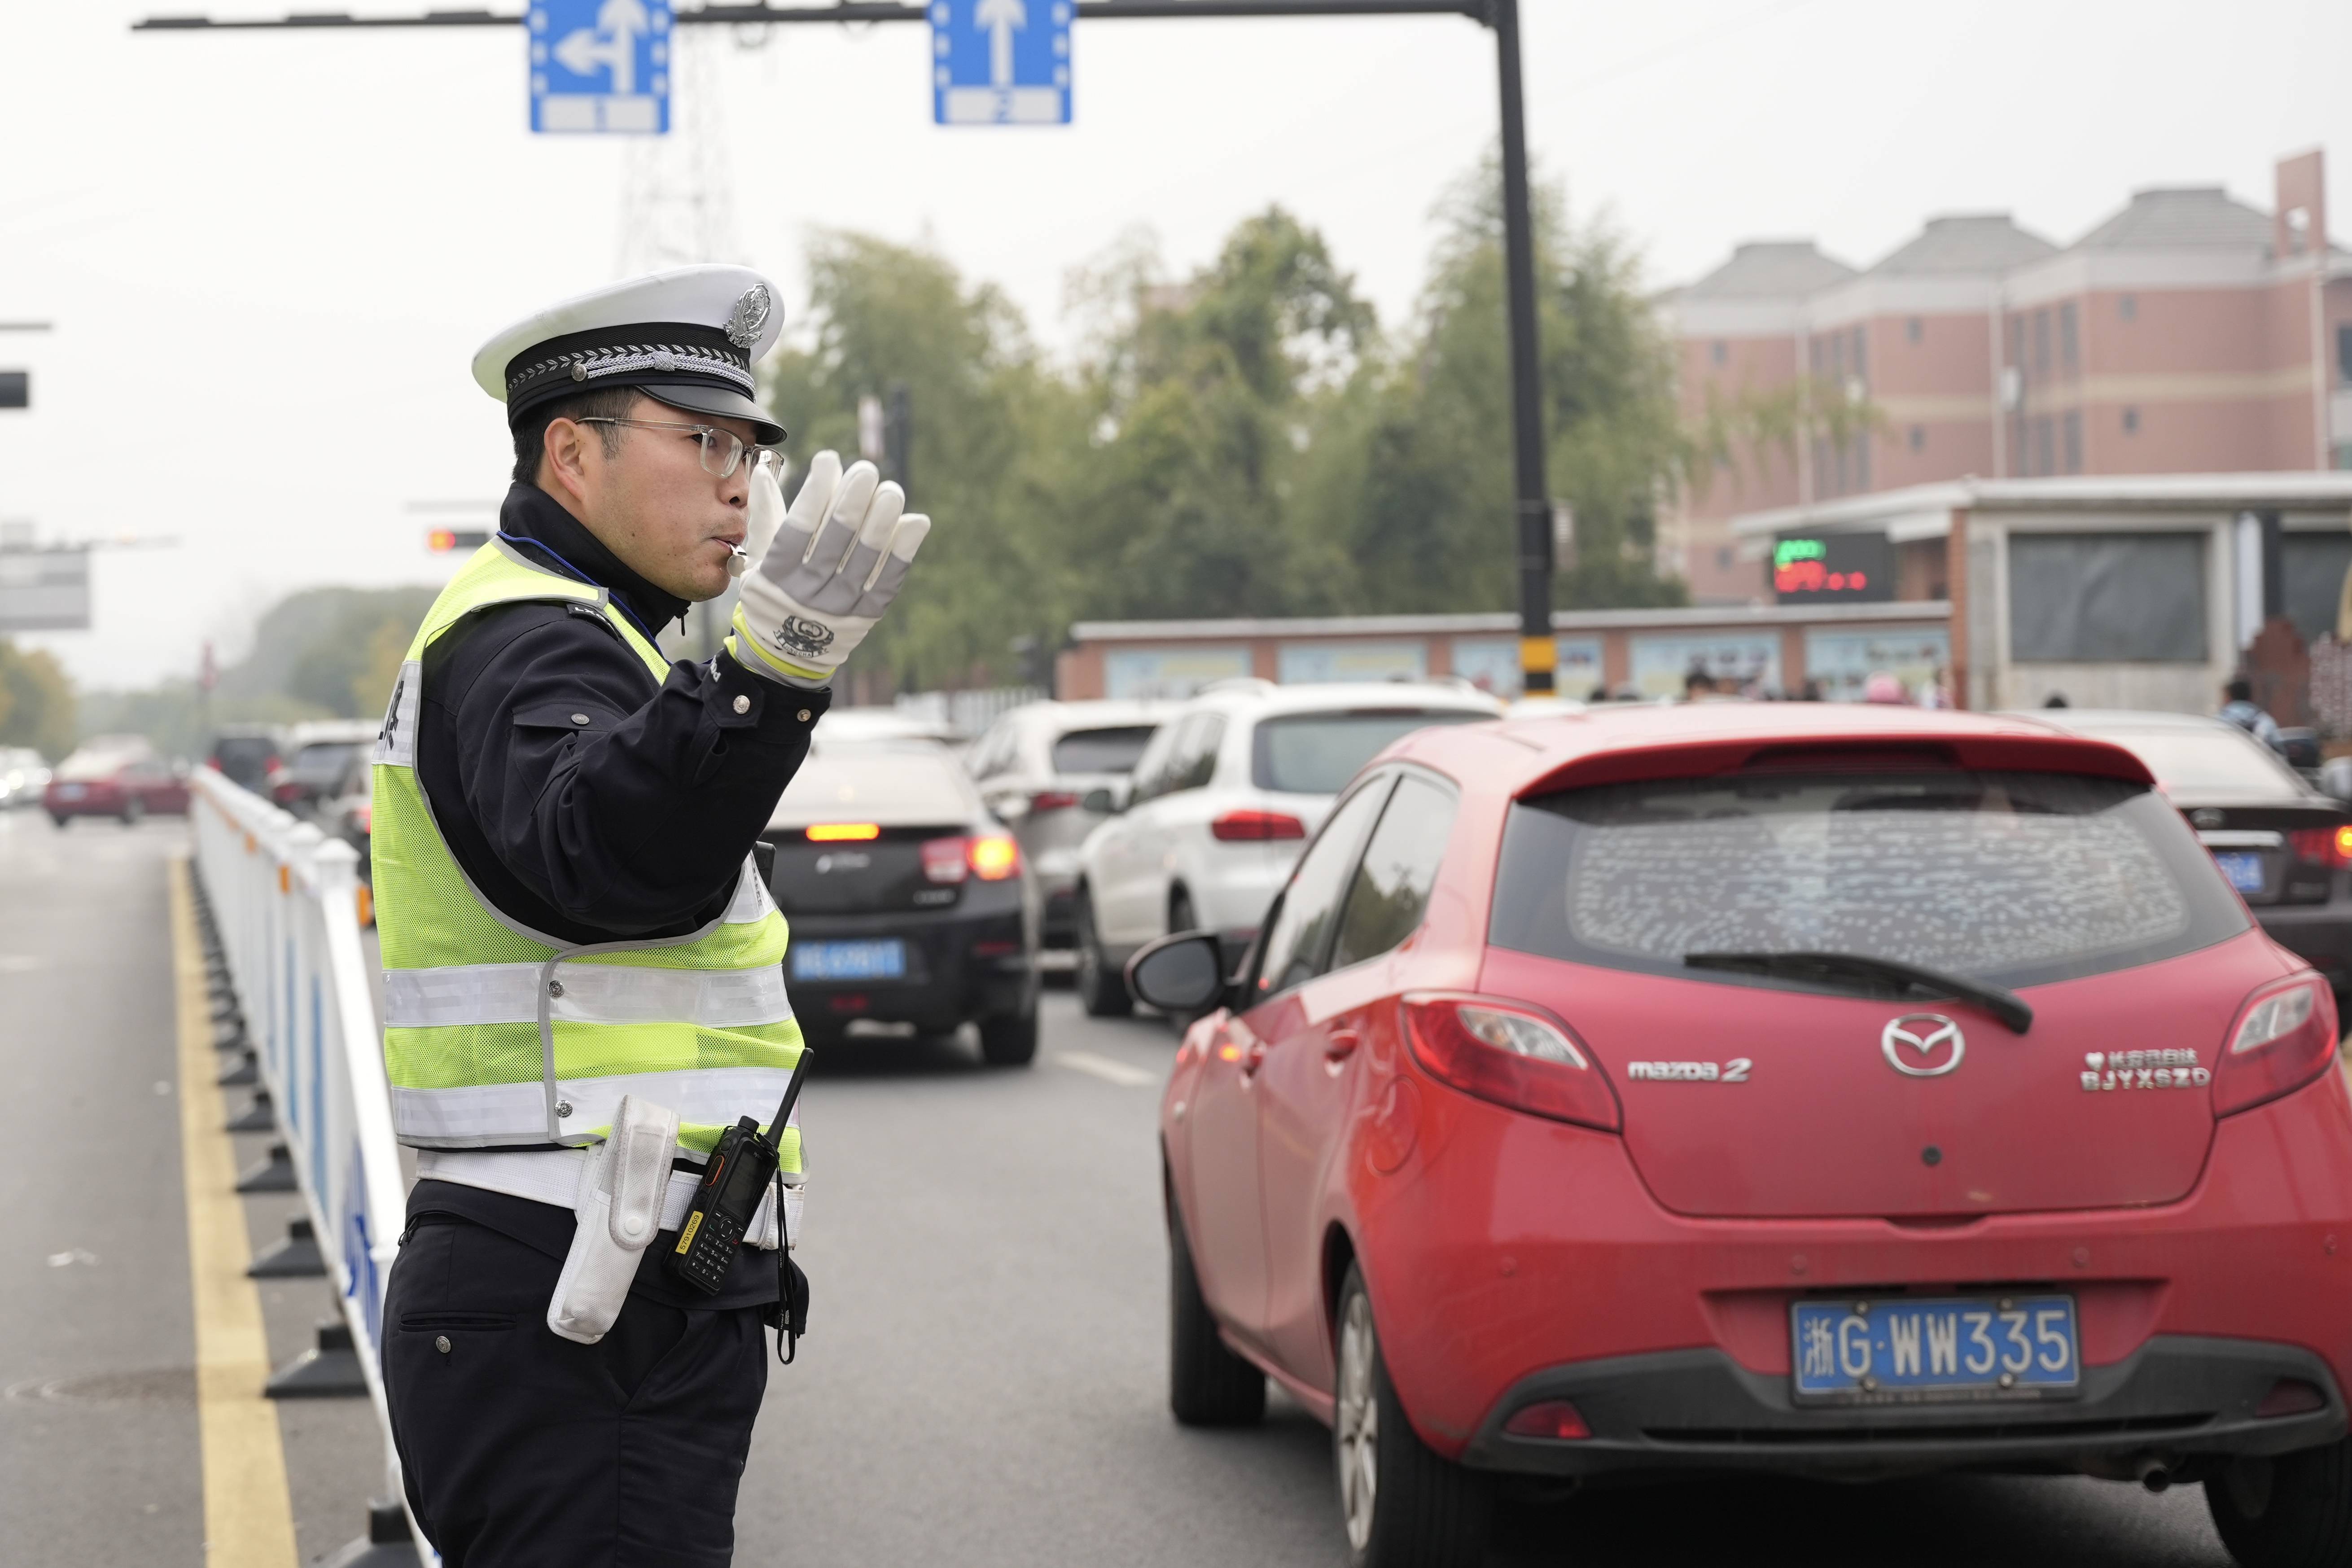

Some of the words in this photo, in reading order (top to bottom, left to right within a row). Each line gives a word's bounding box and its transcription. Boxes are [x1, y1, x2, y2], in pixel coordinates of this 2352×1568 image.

[1627, 1061, 1719, 1081] mazda
[1721, 1058, 1752, 1082] 2
[2080, 1067, 2211, 1091] BJYXSZD
[680, 1215, 700, 1250] 57910269
